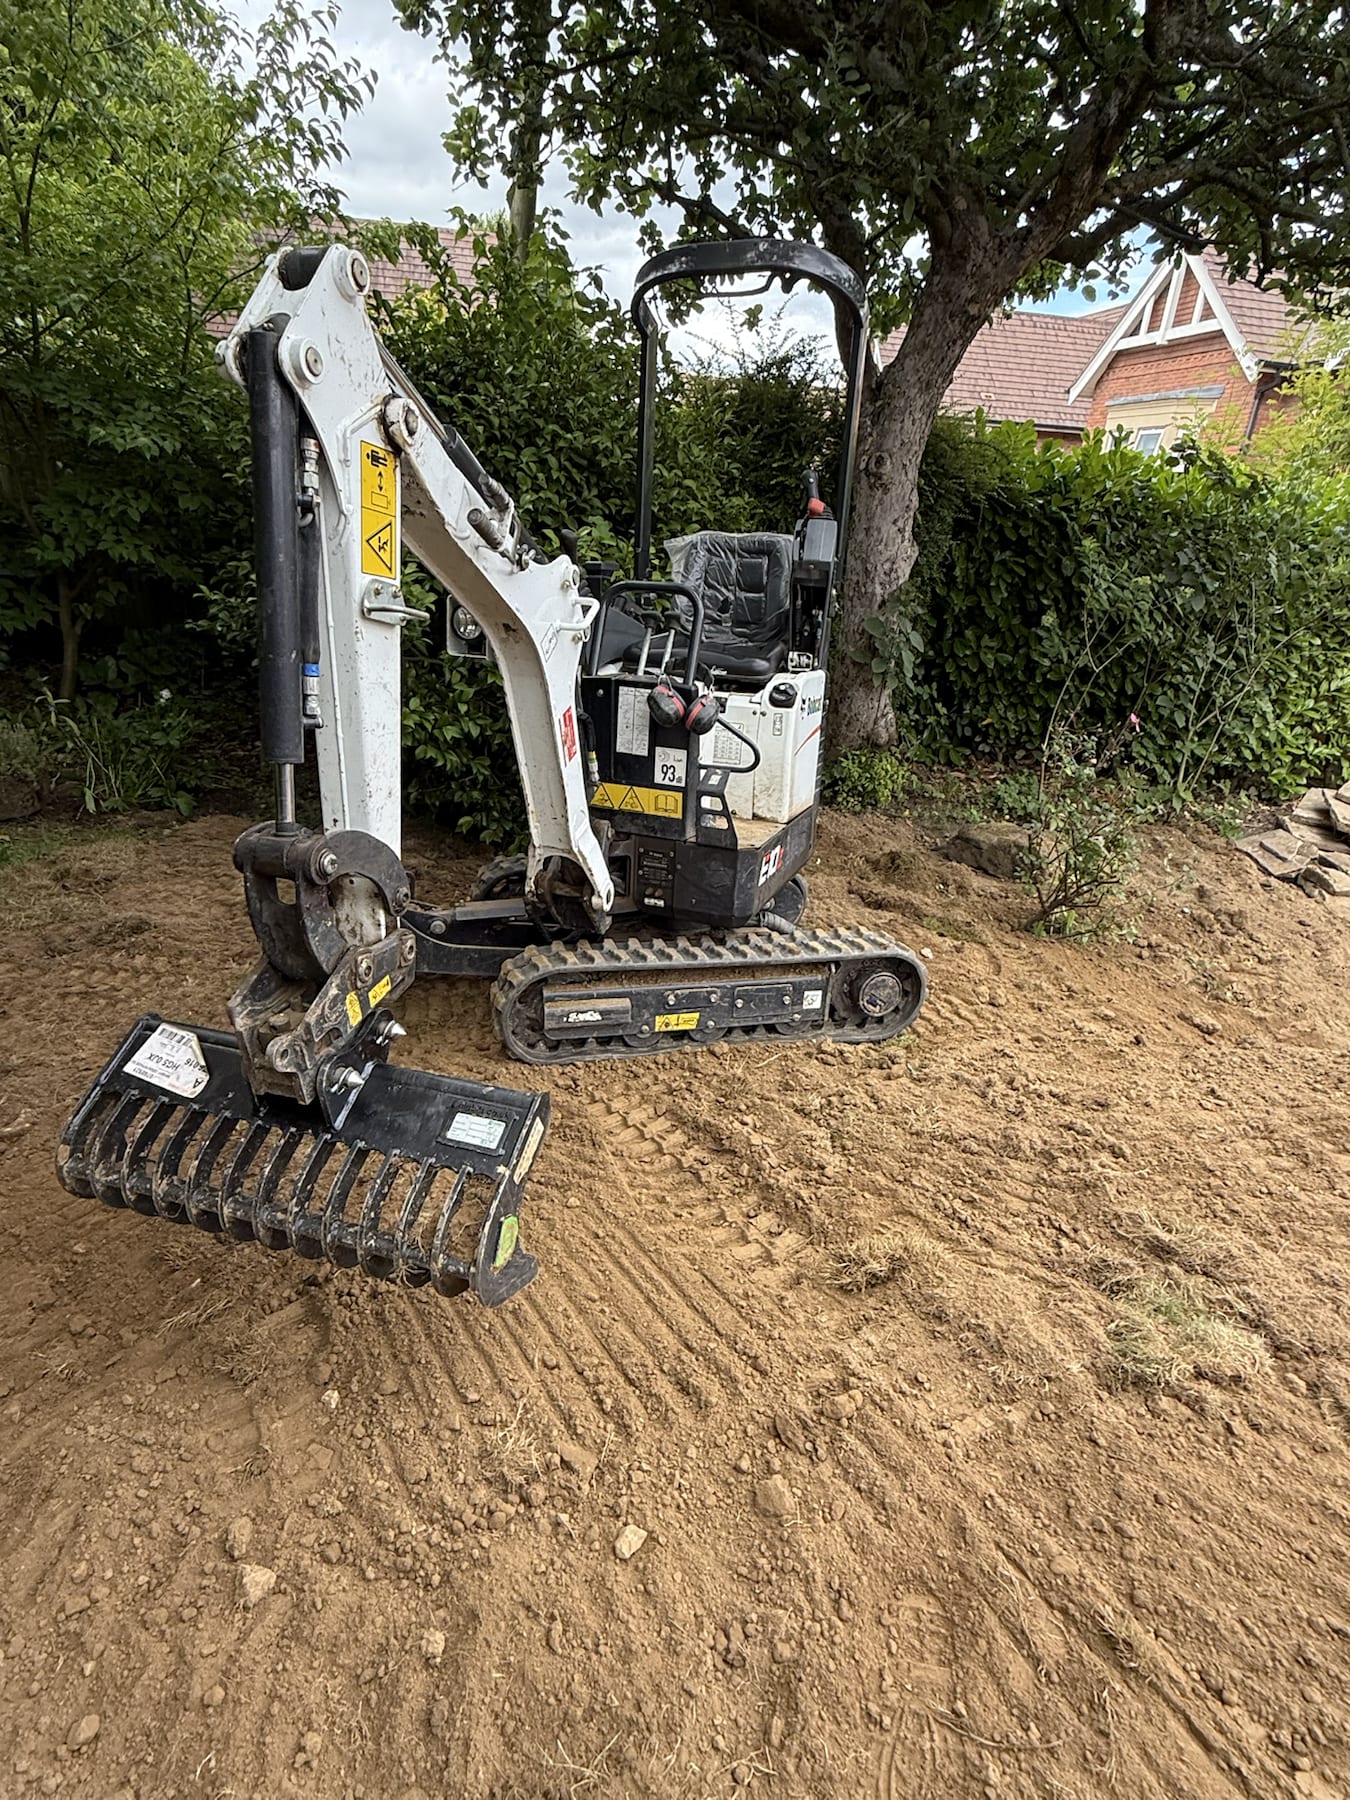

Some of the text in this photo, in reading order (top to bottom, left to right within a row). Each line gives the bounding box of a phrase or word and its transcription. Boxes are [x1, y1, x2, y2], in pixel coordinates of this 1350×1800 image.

[661, 764, 676, 782] 93
[162, 1060, 181, 1071] HG5
[192, 1077, 204, 1089] A
